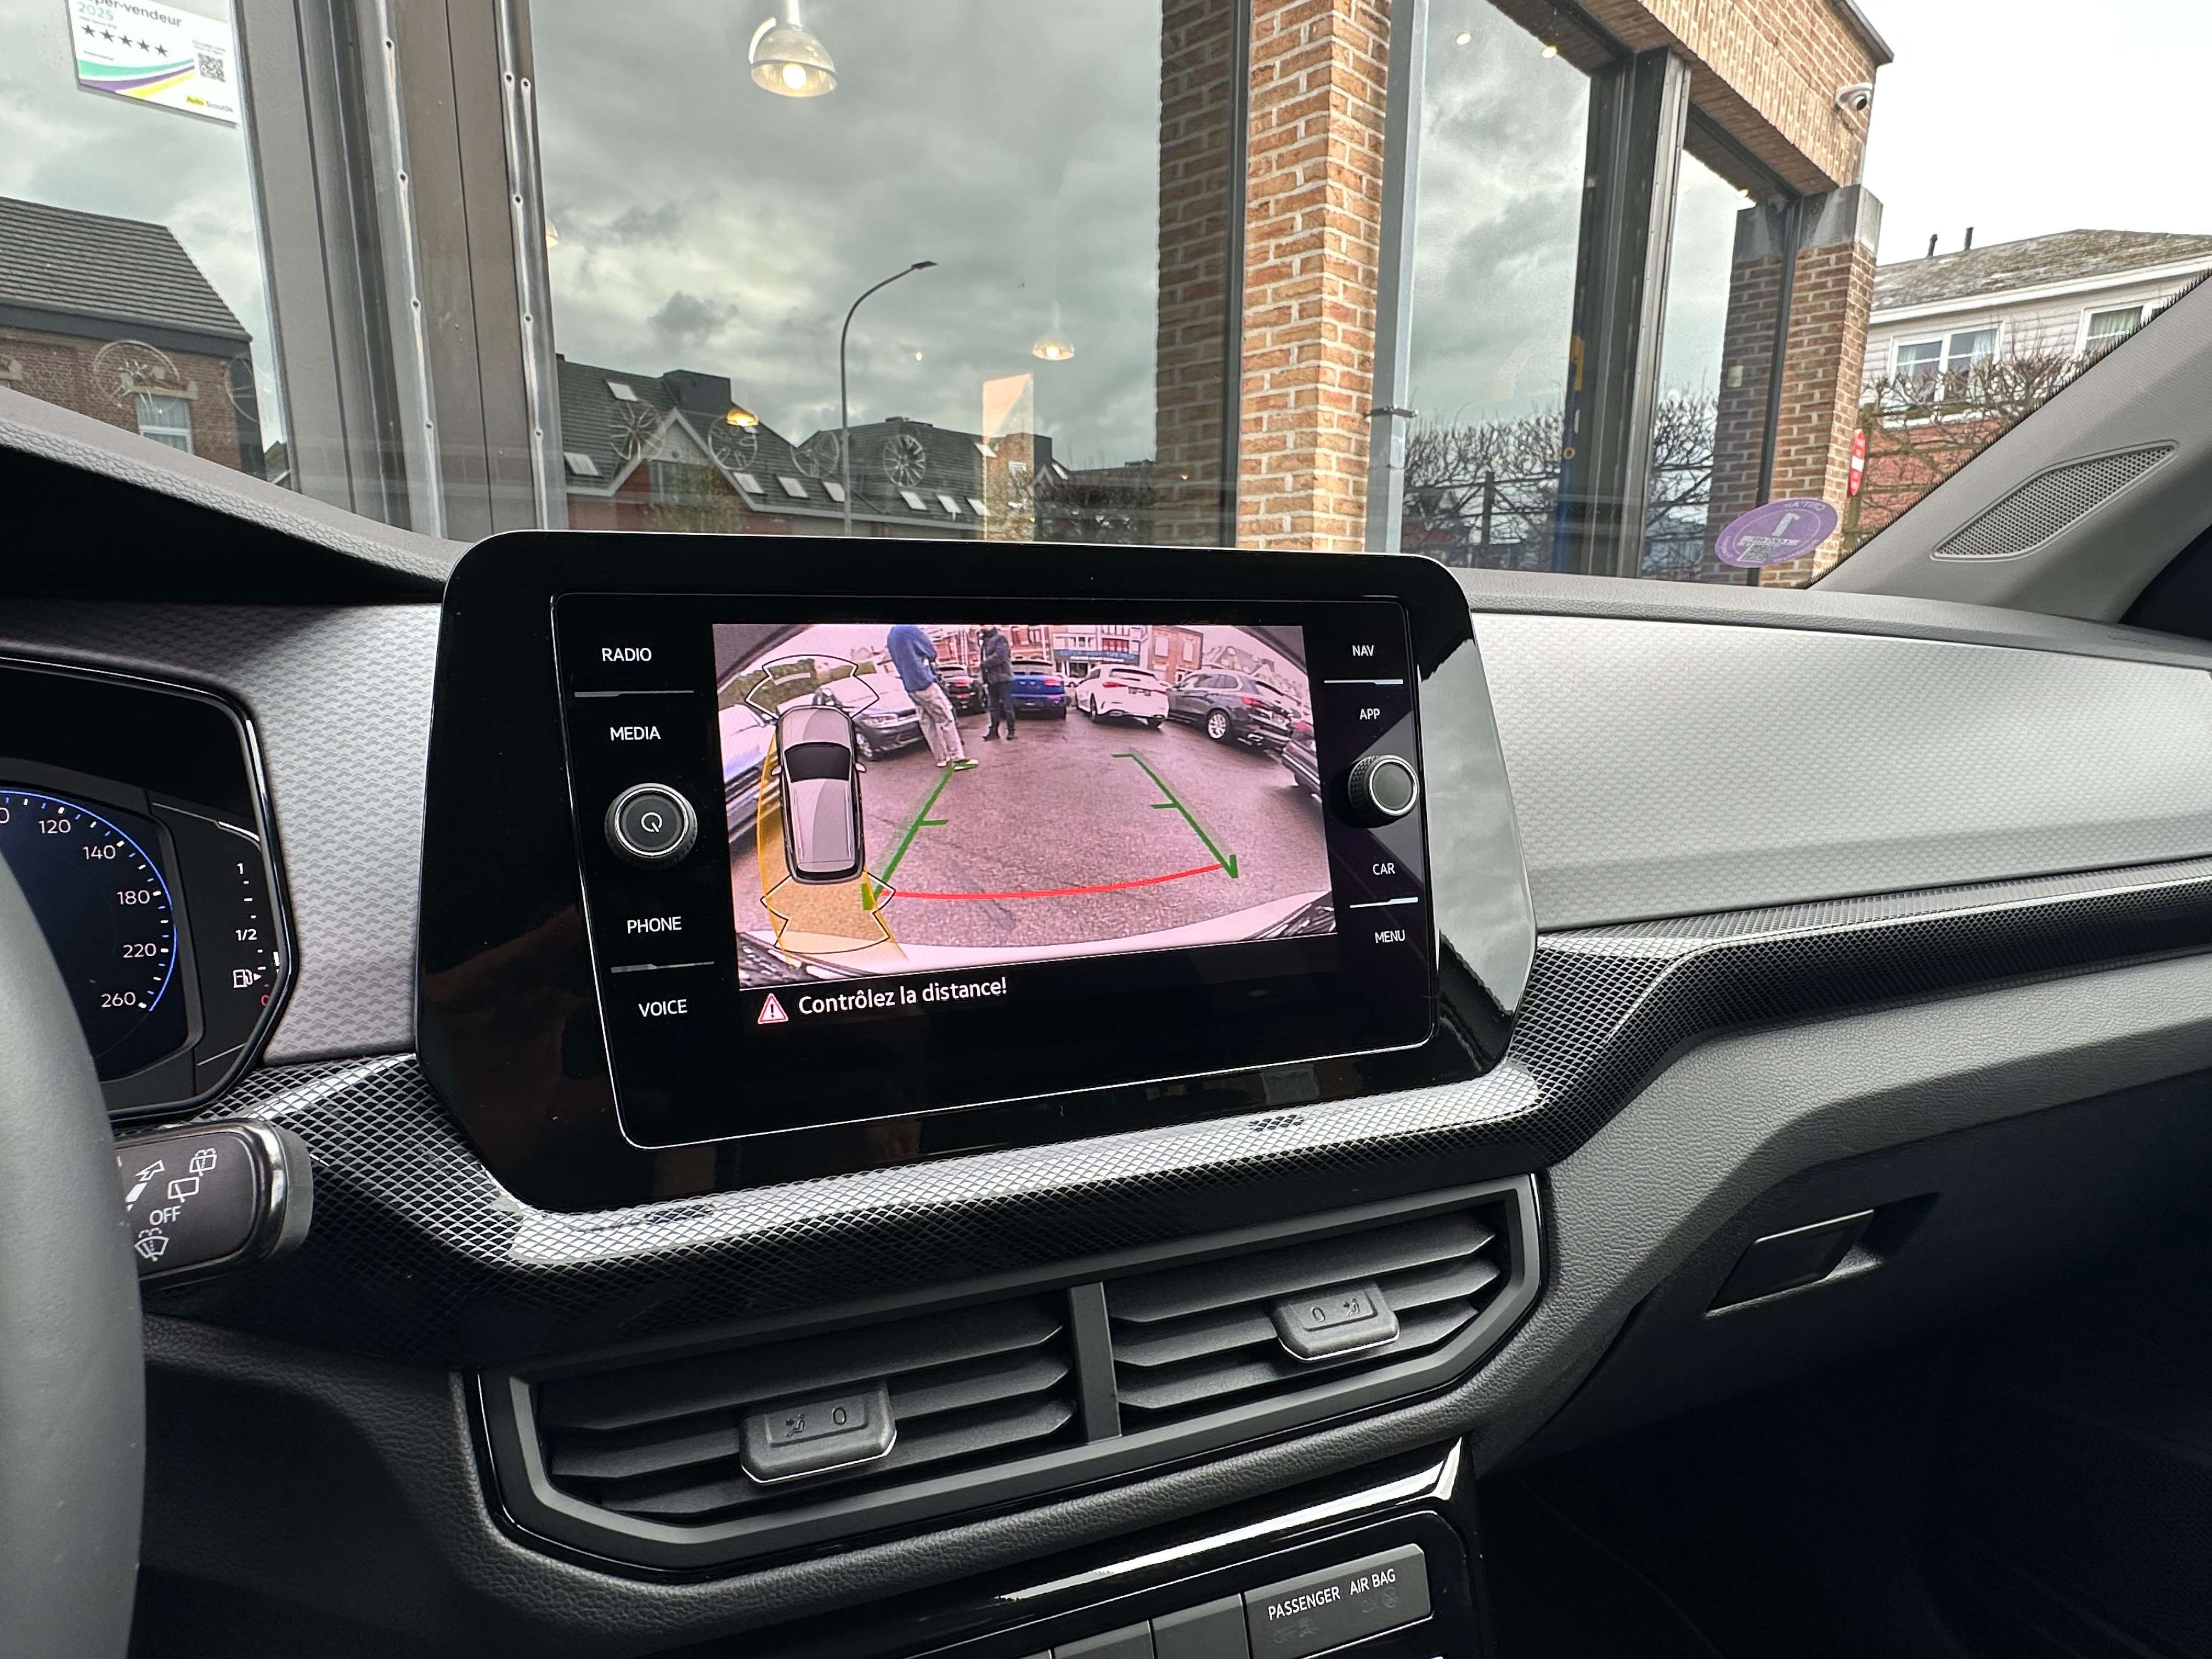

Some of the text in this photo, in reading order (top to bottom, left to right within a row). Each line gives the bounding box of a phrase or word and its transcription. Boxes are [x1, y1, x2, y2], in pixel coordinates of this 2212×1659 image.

[78, 2, 114, 21] 2025
[88, 0, 182, 27] per-vendeur
[601, 647, 652, 662] RADIO
[1352, 645, 1375, 657] NAV
[1359, 708, 1380, 720] APP
[610, 725, 662, 741] MEDIA
[38, 819, 71, 834] 120
[82, 845, 116, 860] 140
[236, 862, 244, 874] 1
[1373, 862, 1396, 876] CAR
[117, 890, 150, 905] 180
[627, 916, 682, 934] PHONE
[235, 928, 258, 941] 1/2
[1375, 929, 1406, 944] MENU
[123, 943, 157, 958] 220
[101, 992, 136, 1008] 260
[799, 977, 1007, 1015] Contrôlez la distance!
[638, 998, 688, 1017] VOICE
[149, 1205, 182, 1226] OFF
[1267, 1585, 1341, 1621] PASSENGER
[1349, 1577, 1370, 1595] AIR
[1372, 1568, 1396, 1588] BAG
